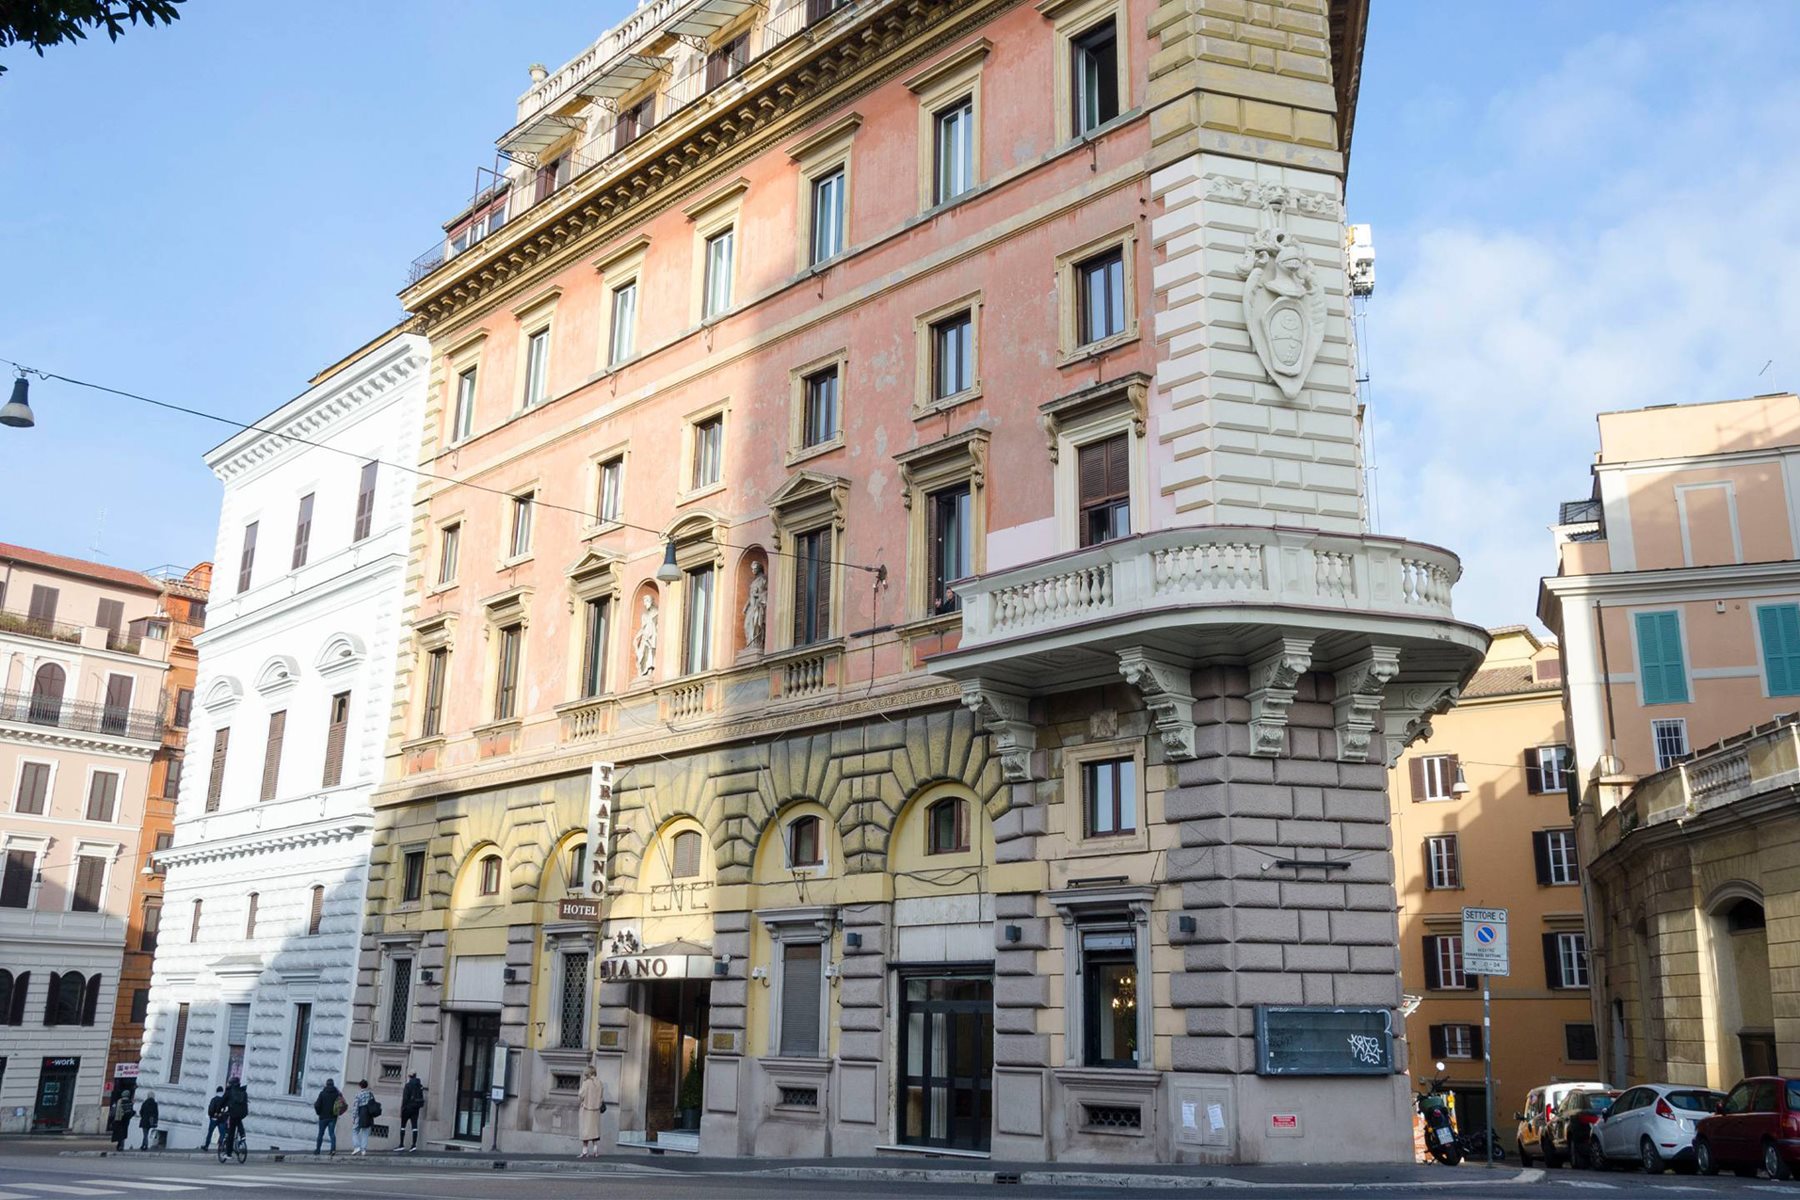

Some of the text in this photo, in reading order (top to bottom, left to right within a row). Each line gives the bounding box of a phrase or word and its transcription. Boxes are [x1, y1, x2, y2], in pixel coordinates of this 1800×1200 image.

[591, 766, 612, 894] TRAIANO
[563, 903, 598, 916] HOTEL
[1465, 910, 1504, 920] SETTORE C
